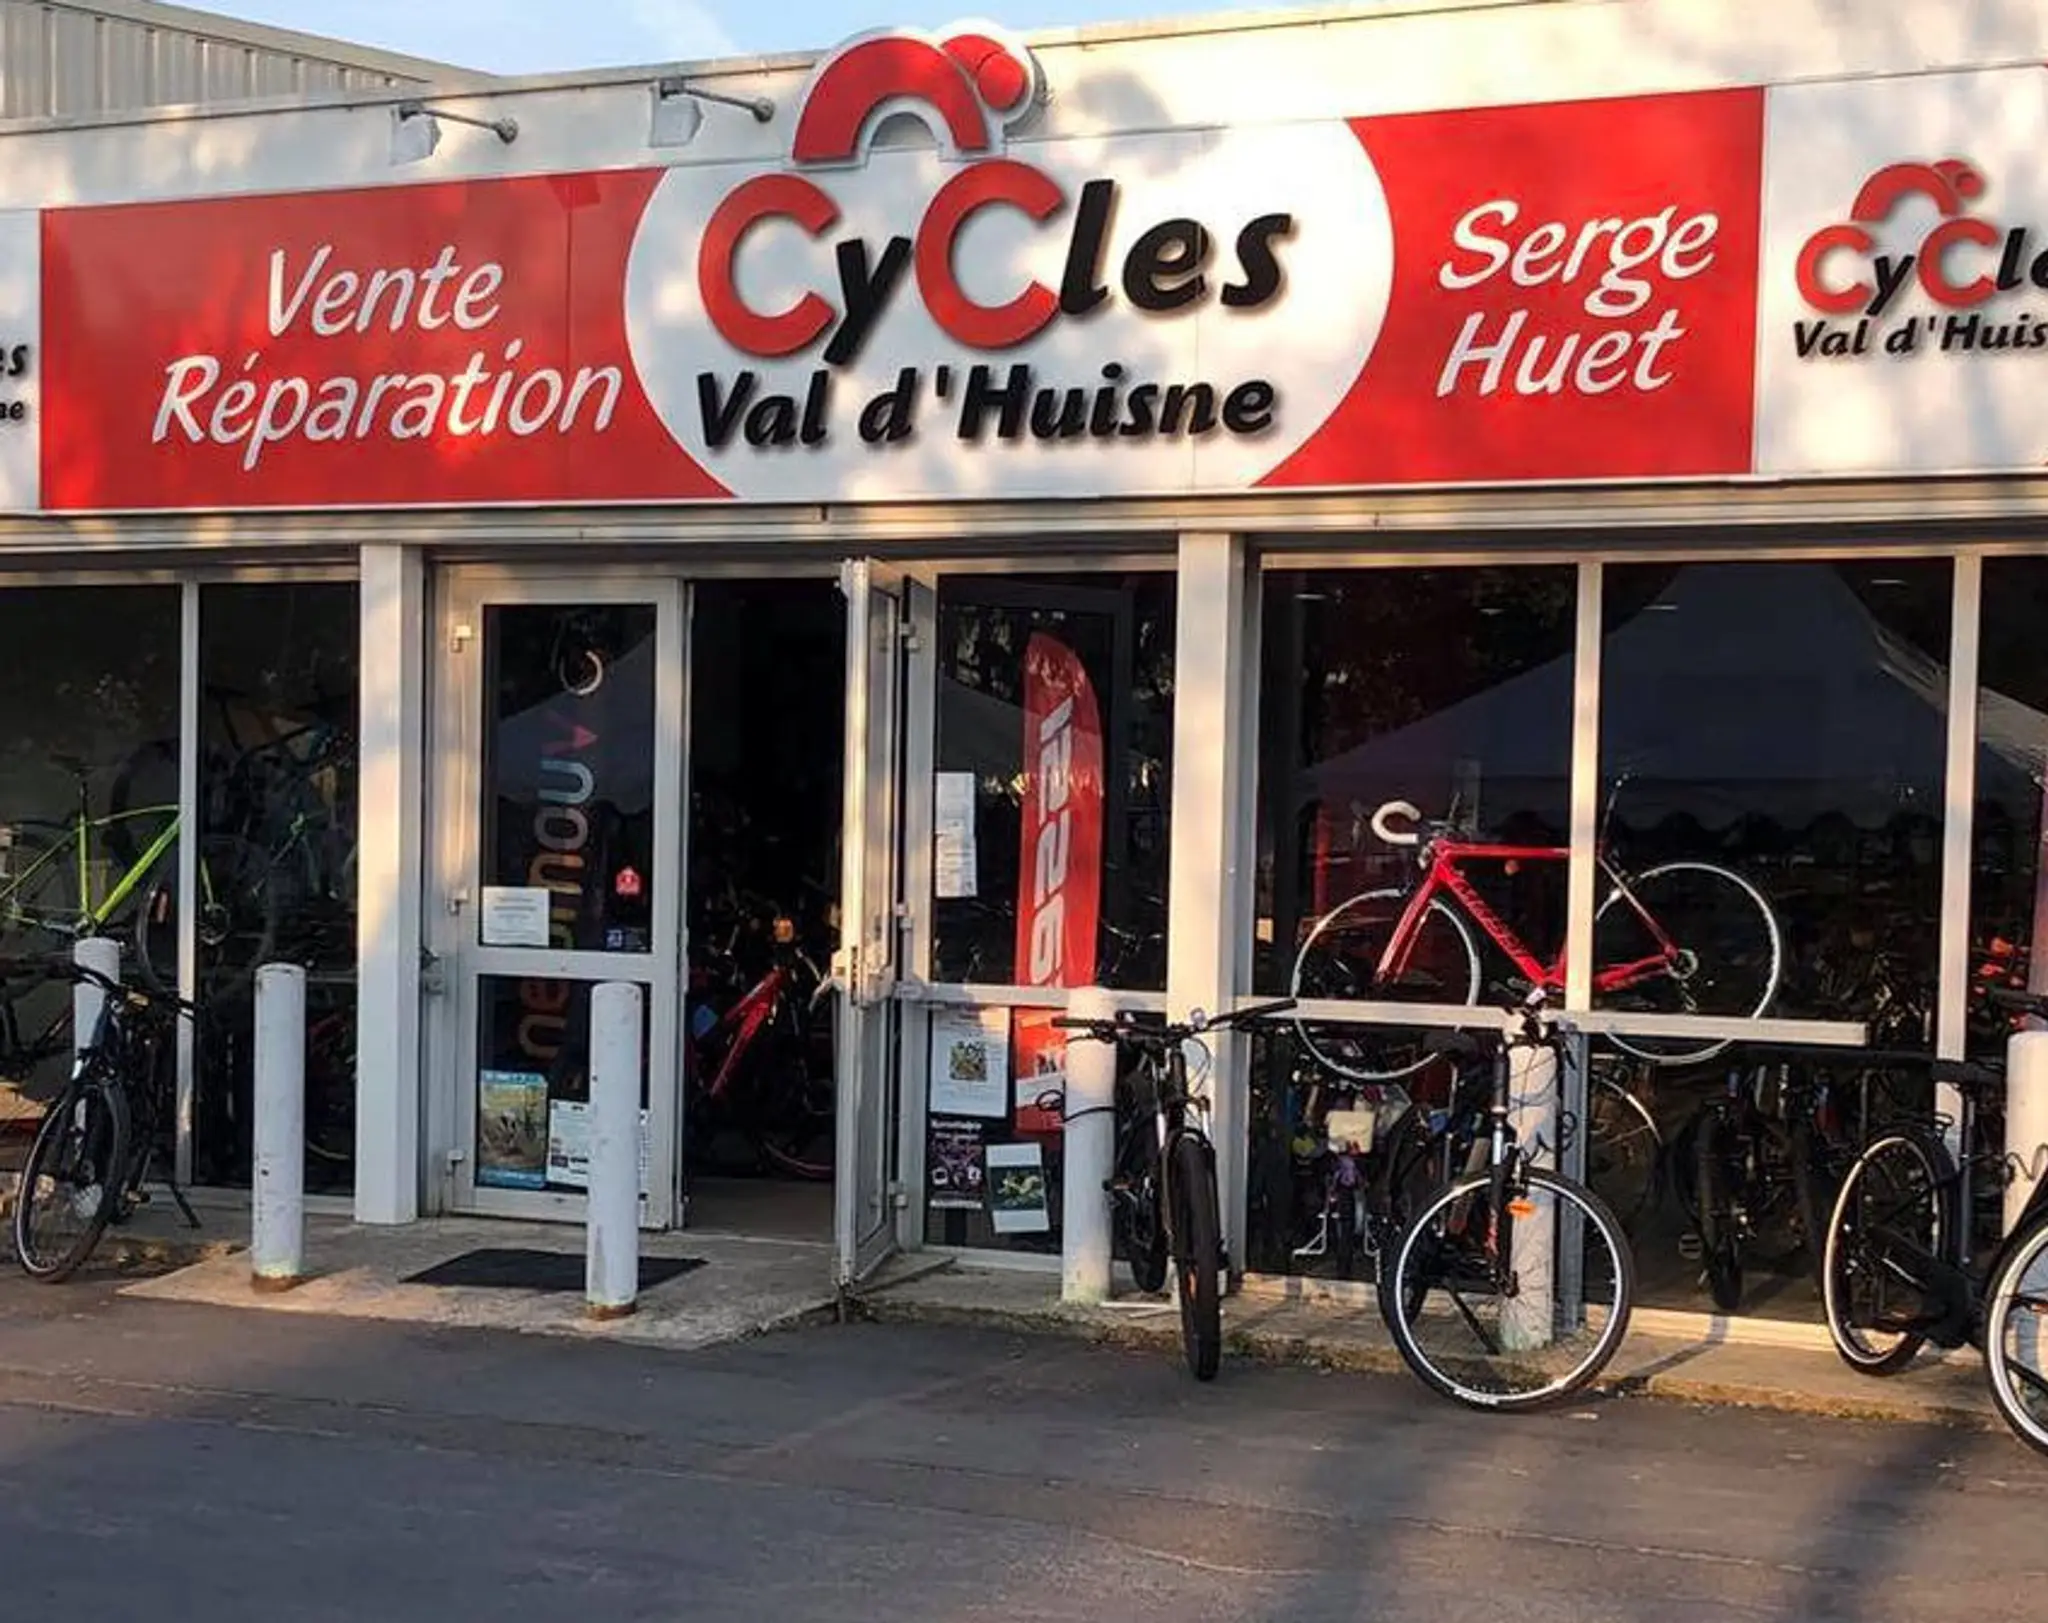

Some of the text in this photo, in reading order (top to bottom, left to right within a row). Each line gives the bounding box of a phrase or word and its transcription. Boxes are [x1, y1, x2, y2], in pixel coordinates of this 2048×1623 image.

[267, 243, 503, 337] Vente
[1438, 199, 1719, 317] Serge
[1436, 308, 1684, 397] Huet
[1793, 318, 1869, 358] Val
[151, 338, 623, 471] Réparation
[696, 361, 1276, 447] Val d'Huisne
